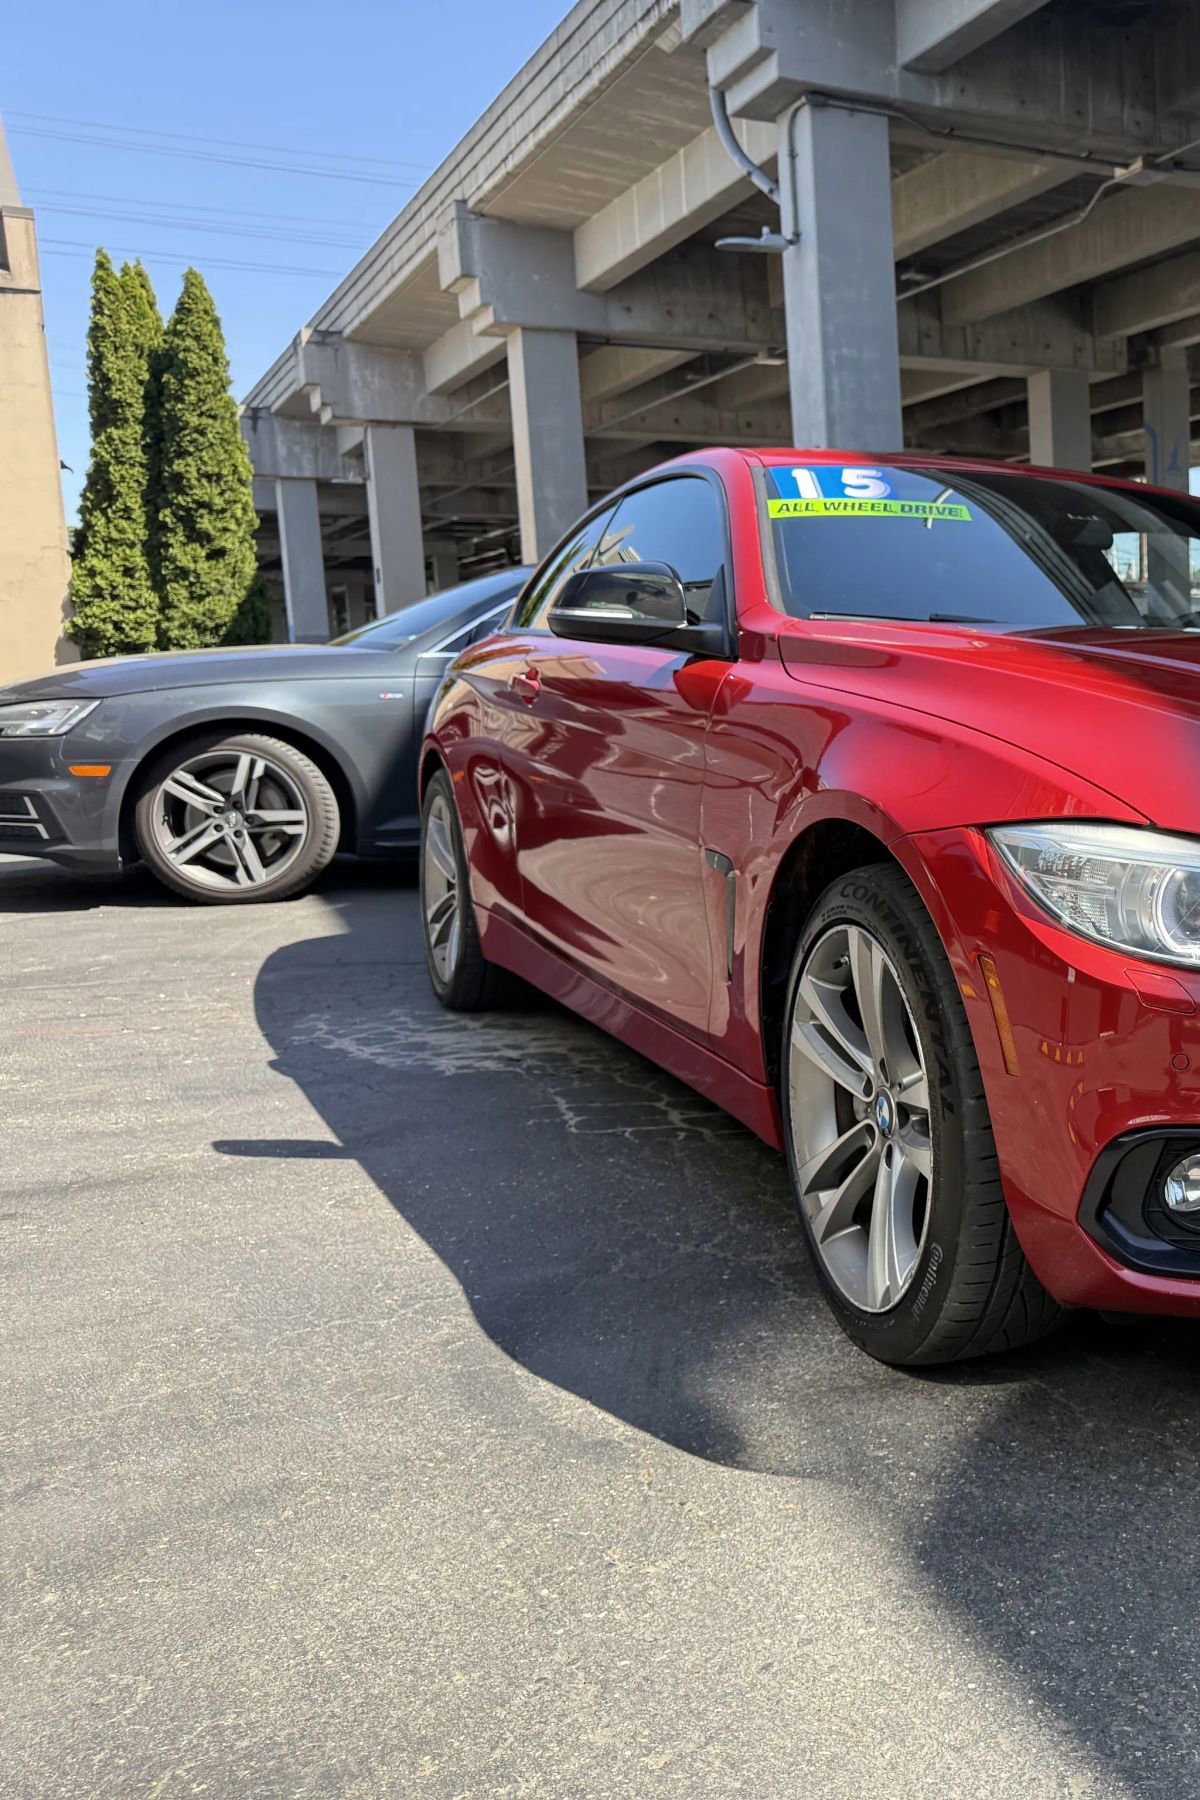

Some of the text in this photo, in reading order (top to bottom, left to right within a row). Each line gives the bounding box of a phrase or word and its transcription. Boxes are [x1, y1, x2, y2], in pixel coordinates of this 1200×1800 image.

[777, 502, 817, 514] ALL
[823, 501, 897, 514] WHEEL
[840, 881, 954, 1118] CONTINENTAL
[911, 1242, 943, 1321] Continental
